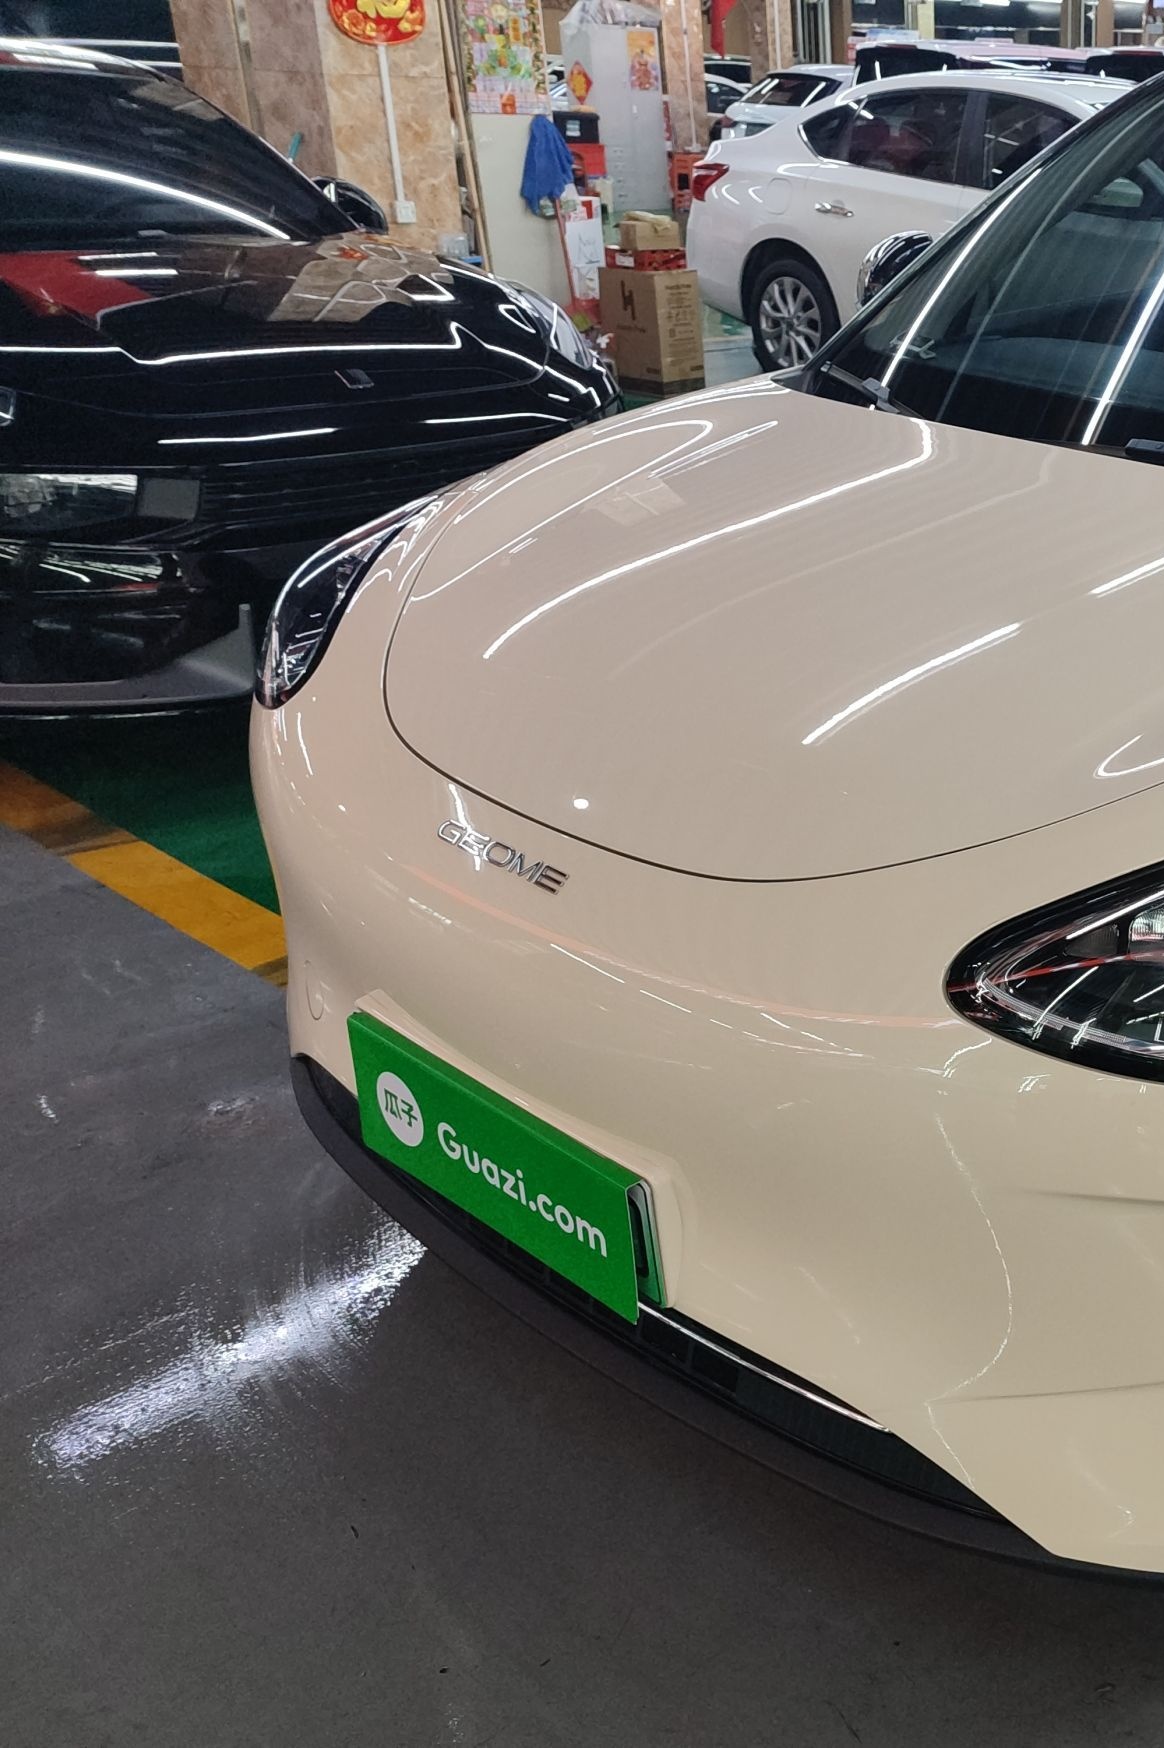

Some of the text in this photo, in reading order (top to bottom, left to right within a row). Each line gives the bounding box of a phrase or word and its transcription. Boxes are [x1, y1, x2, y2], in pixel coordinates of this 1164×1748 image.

[437, 819, 570, 895] GEOME
[383, 1087, 418, 1128] 瓜子
[437, 1121, 608, 1258] Guazi.com
